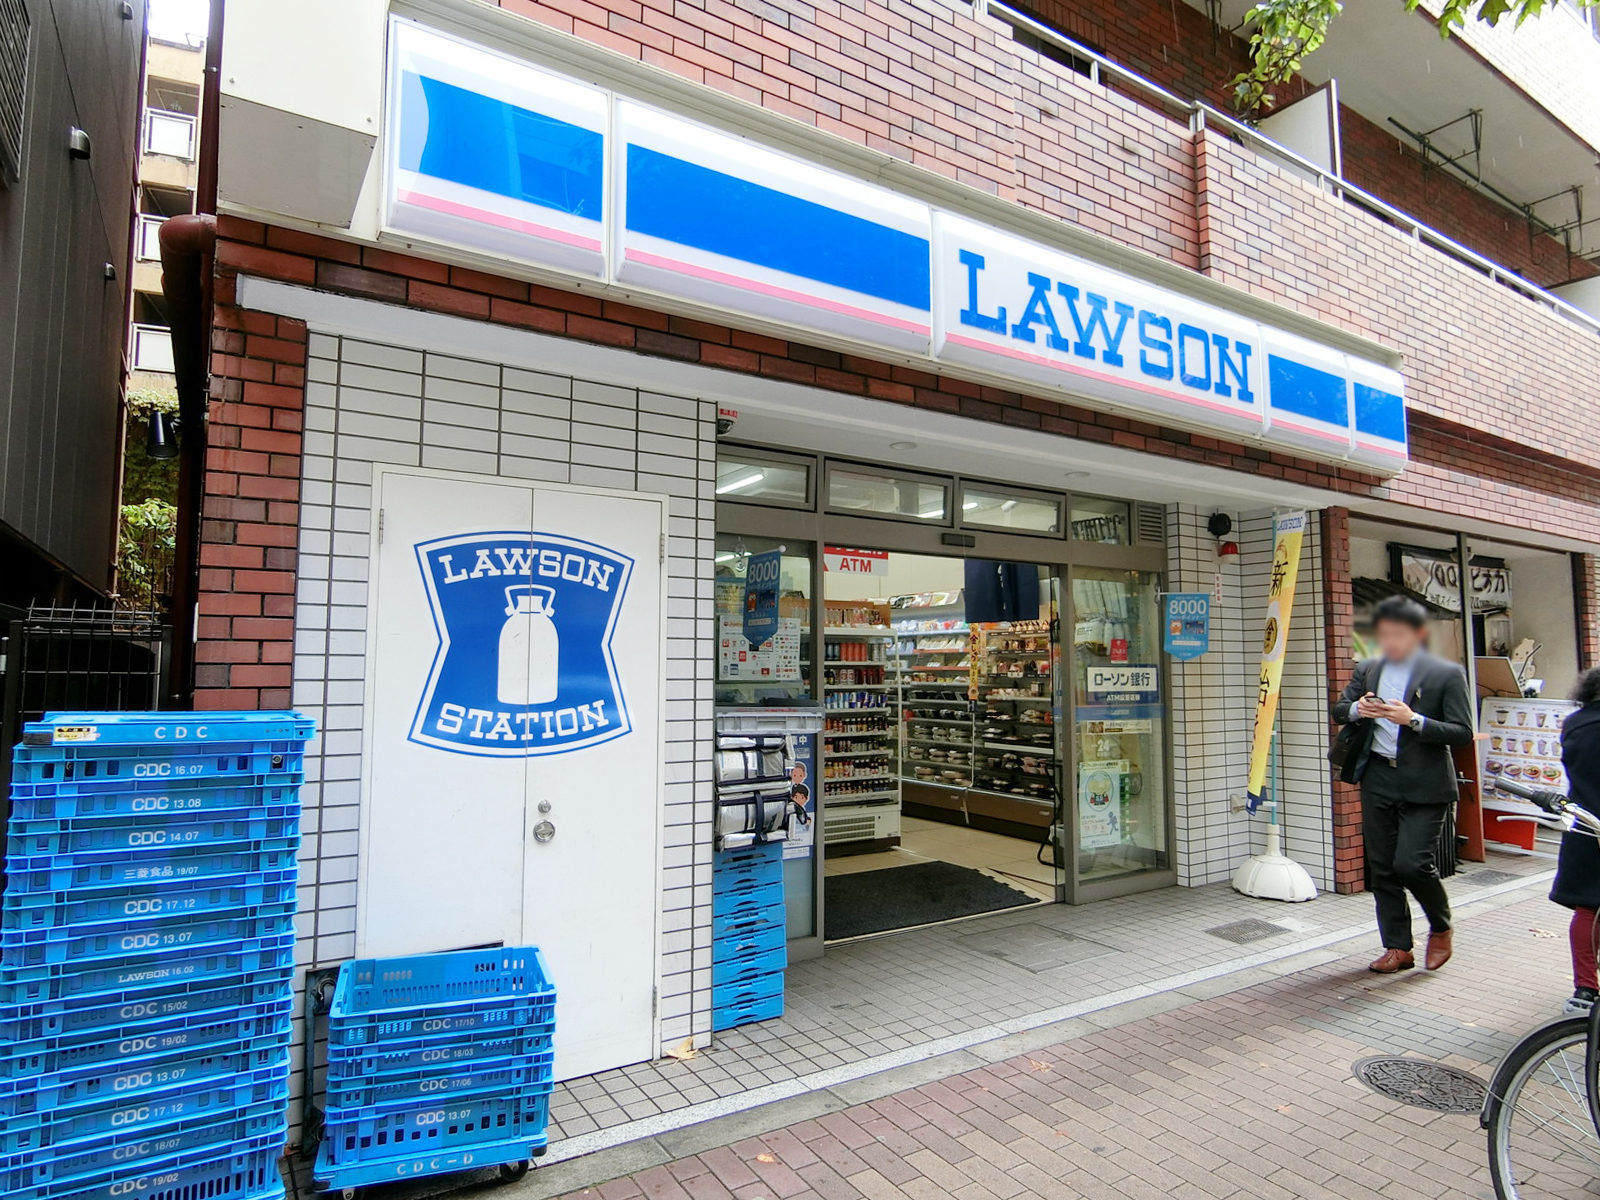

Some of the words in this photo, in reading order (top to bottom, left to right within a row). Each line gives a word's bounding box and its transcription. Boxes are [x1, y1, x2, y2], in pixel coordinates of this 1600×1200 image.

[959, 248, 1254, 403] LAWSON
[438, 548, 615, 592] LAWSON
[748, 560, 779, 582] 8000
[839, 557, 872, 573] ATM
[1169, 600, 1207, 615] 8000
[1094, 672, 1151, 687] ローソン銀行
[436, 699, 609, 741] STATION
[134, 763, 171, 777] CDC
[174, 764, 204, 775] 16.07
[132, 797, 169, 811] CDC
[173, 798, 201, 808] 13.08
[128, 831, 166, 846] CDC
[170, 831, 199, 842] 14.07
[123, 866, 174, 879] 三菱食品
[176, 866, 199, 875] 19/07
[124, 899, 163, 915] CDC
[165, 899, 196, 911] 17.12
[121, 933, 159, 950] CDC
[163, 932, 193, 944] 13.07
[118, 969, 170, 983] LAWSON
[172, 965, 195, 976] 16.02
[120, 1003, 158, 1019] CDC
[162, 1001, 188, 1013] 15/02
[423, 1018, 452, 1032] CDC
[455, 1017, 475, 1028] 17/10
[119, 1037, 157, 1054] CDC
[161, 1035, 188, 1047] 19/02
[421, 1048, 450, 1062] CDC
[453, 1047, 474, 1058] 18/03
[113, 1073, 152, 1092] CDC
[156, 1069, 186, 1082] 13.07
[419, 1078, 449, 1092] CDC
[111, 1107, 150, 1127] CDC
[154, 1103, 183, 1116] 17.12
[416, 1111, 446, 1126] CDC
[448, 1109, 471, 1121] 13.07
[112, 1142, 150, 1160] CDC
[154, 1138, 181, 1152] 18/07
[110, 1177, 148, 1196] CDC
[152, 1173, 179, 1186] 19/02
